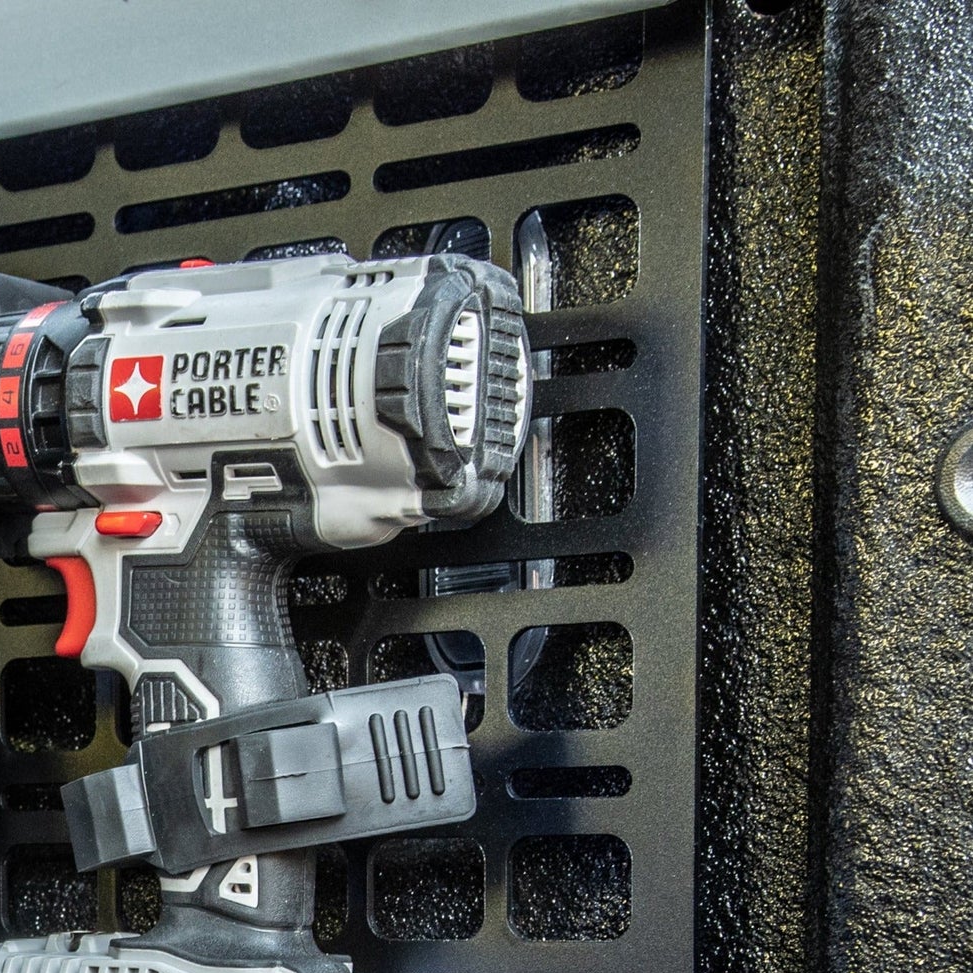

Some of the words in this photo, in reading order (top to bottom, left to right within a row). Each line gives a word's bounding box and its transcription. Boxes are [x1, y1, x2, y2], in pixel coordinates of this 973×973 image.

[171, 345, 287, 384] PORTER
[2, 389, 14, 405] 4
[170, 382, 263, 419] CABLE
[6, 441, 20, 455] 2
